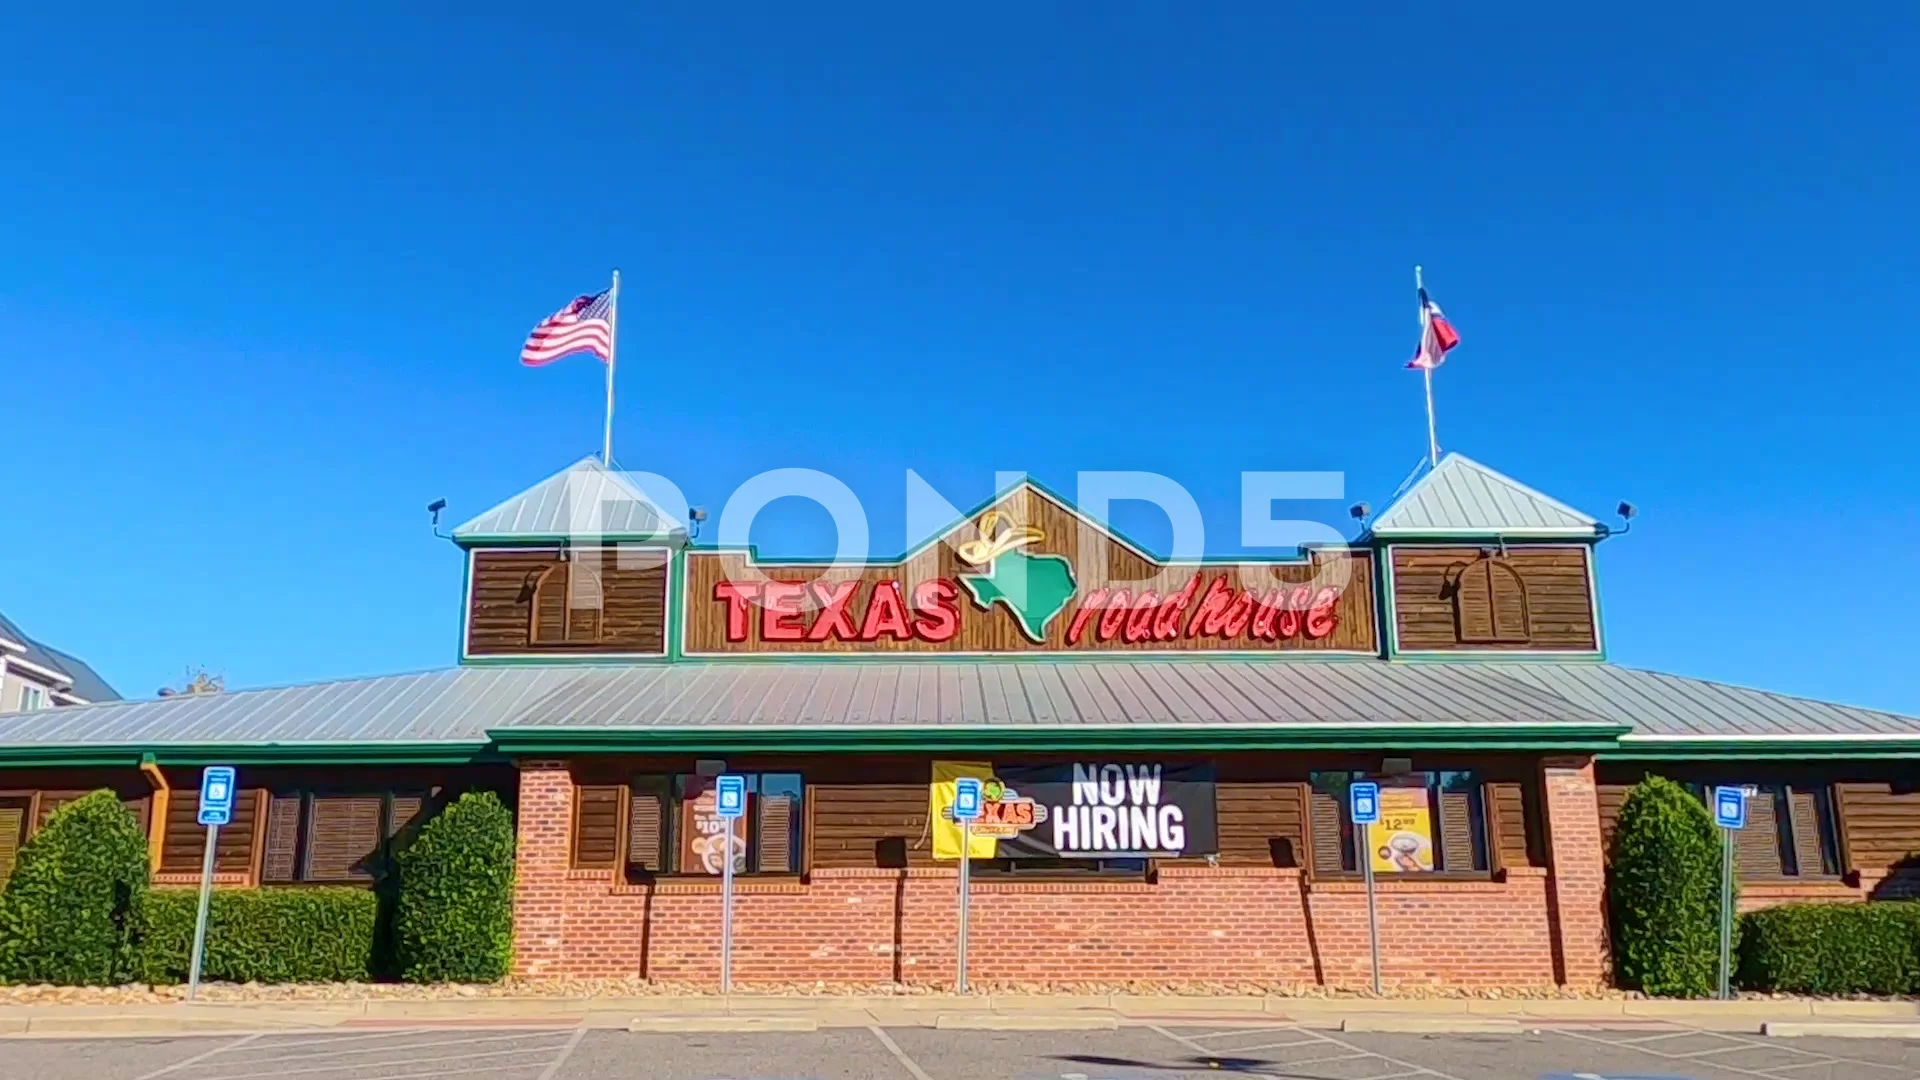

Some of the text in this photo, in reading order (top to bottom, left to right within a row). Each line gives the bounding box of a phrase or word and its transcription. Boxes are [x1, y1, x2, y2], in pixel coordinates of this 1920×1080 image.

[713, 579, 960, 642] TEXAS
[1072, 762, 1162, 806] NOW
[970, 802, 1033, 824] XAS
[1053, 804, 1185, 850] HIRING
